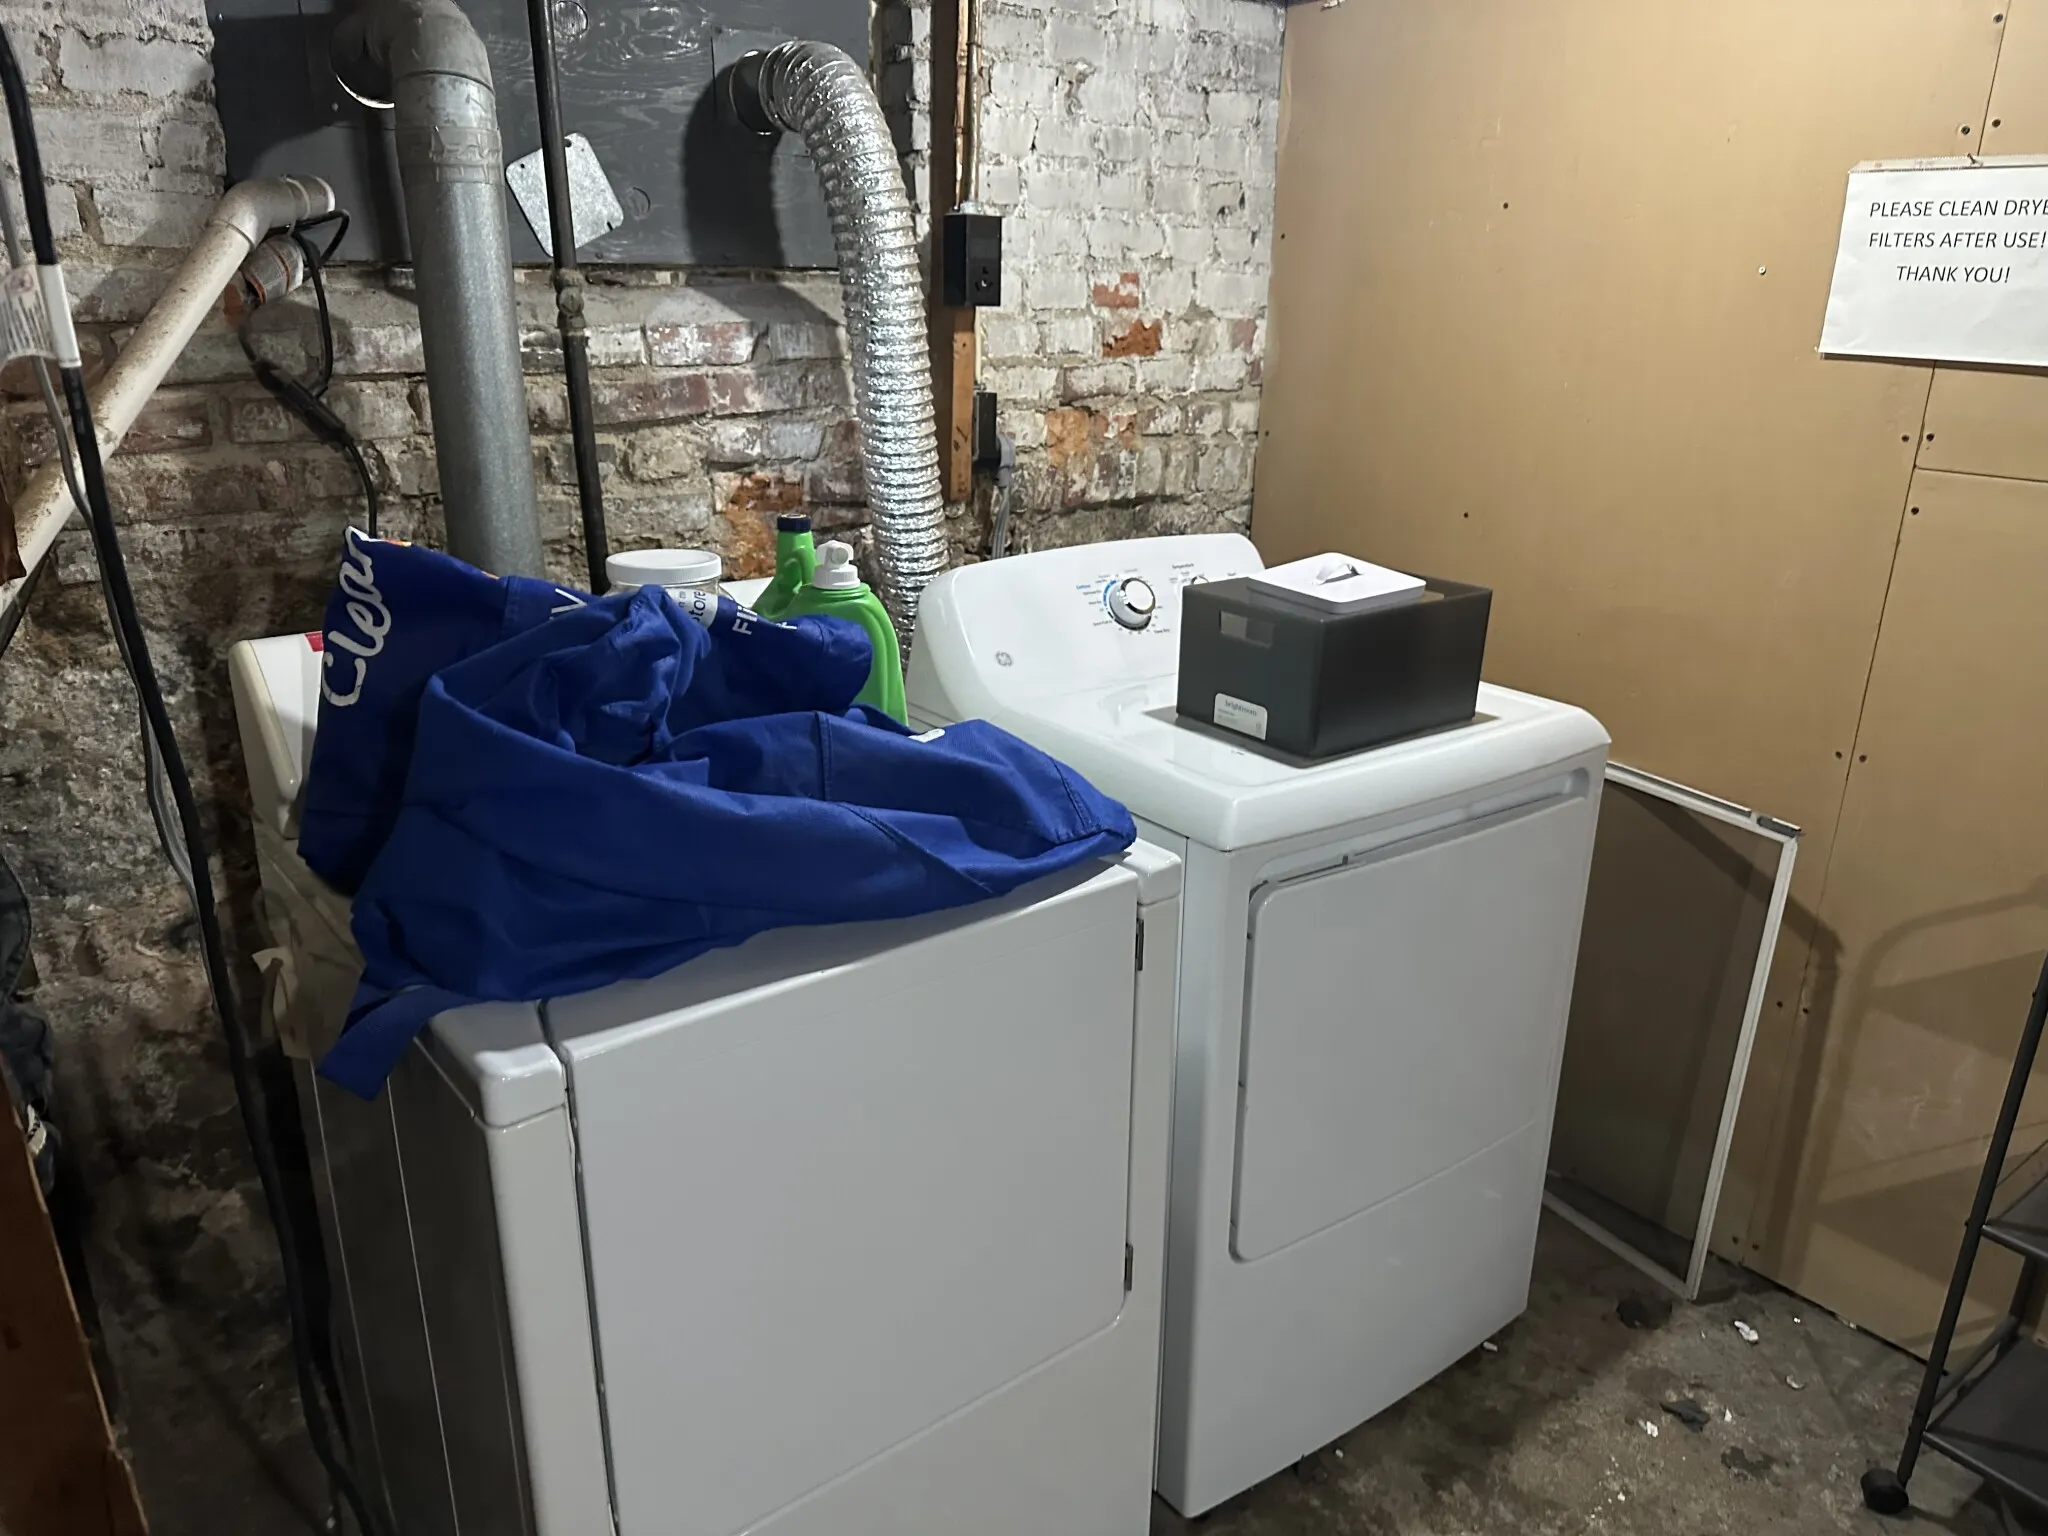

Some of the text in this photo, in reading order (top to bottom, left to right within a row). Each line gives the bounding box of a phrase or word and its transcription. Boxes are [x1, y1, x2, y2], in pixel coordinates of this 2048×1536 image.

[1869, 201, 1934, 218] PLEASE
[1938, 200, 1999, 217] CLEAN
[1868, 230, 2047, 249] FILTERS AFTER USE!
[1896, 265, 2011, 284] THANK YOU!
